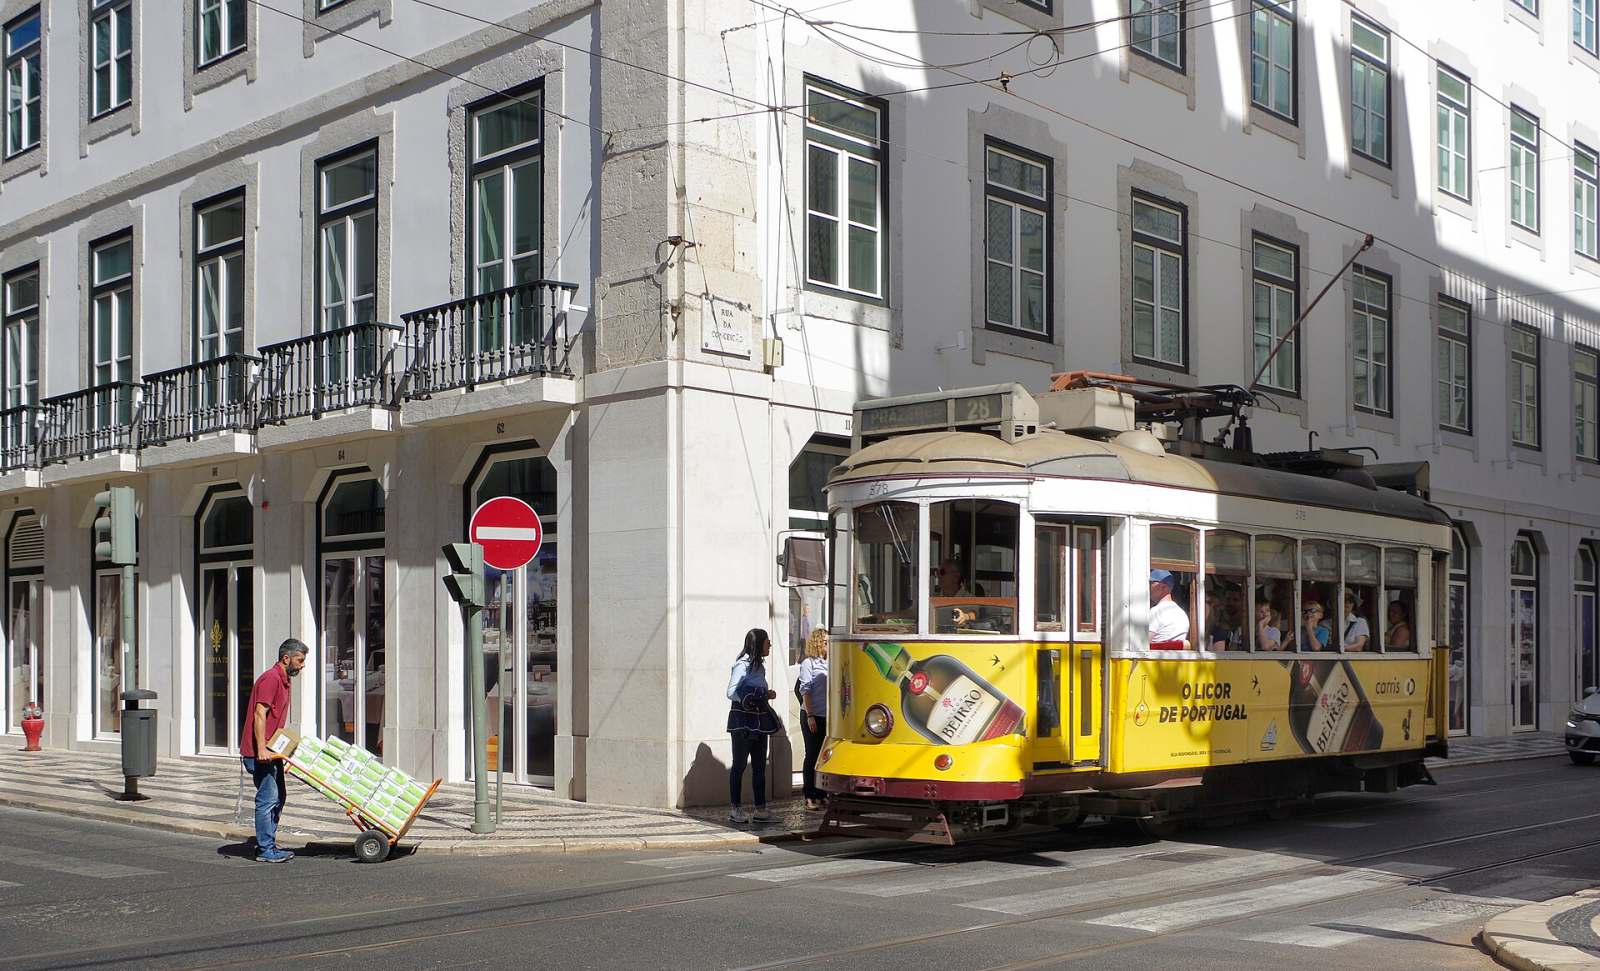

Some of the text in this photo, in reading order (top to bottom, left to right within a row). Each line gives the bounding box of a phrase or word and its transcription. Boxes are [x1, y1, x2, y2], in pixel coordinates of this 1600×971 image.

[721, 308, 734, 318] RUA
[723, 320, 732, 329] DA
[967, 399, 990, 419] 28
[1182, 682, 1232, 700] O LICOR
[1375, 677, 1400, 695] carris
[942, 689, 982, 739] BEIRÃO
[1159, 703, 1248, 723] DE PORTUGAL
